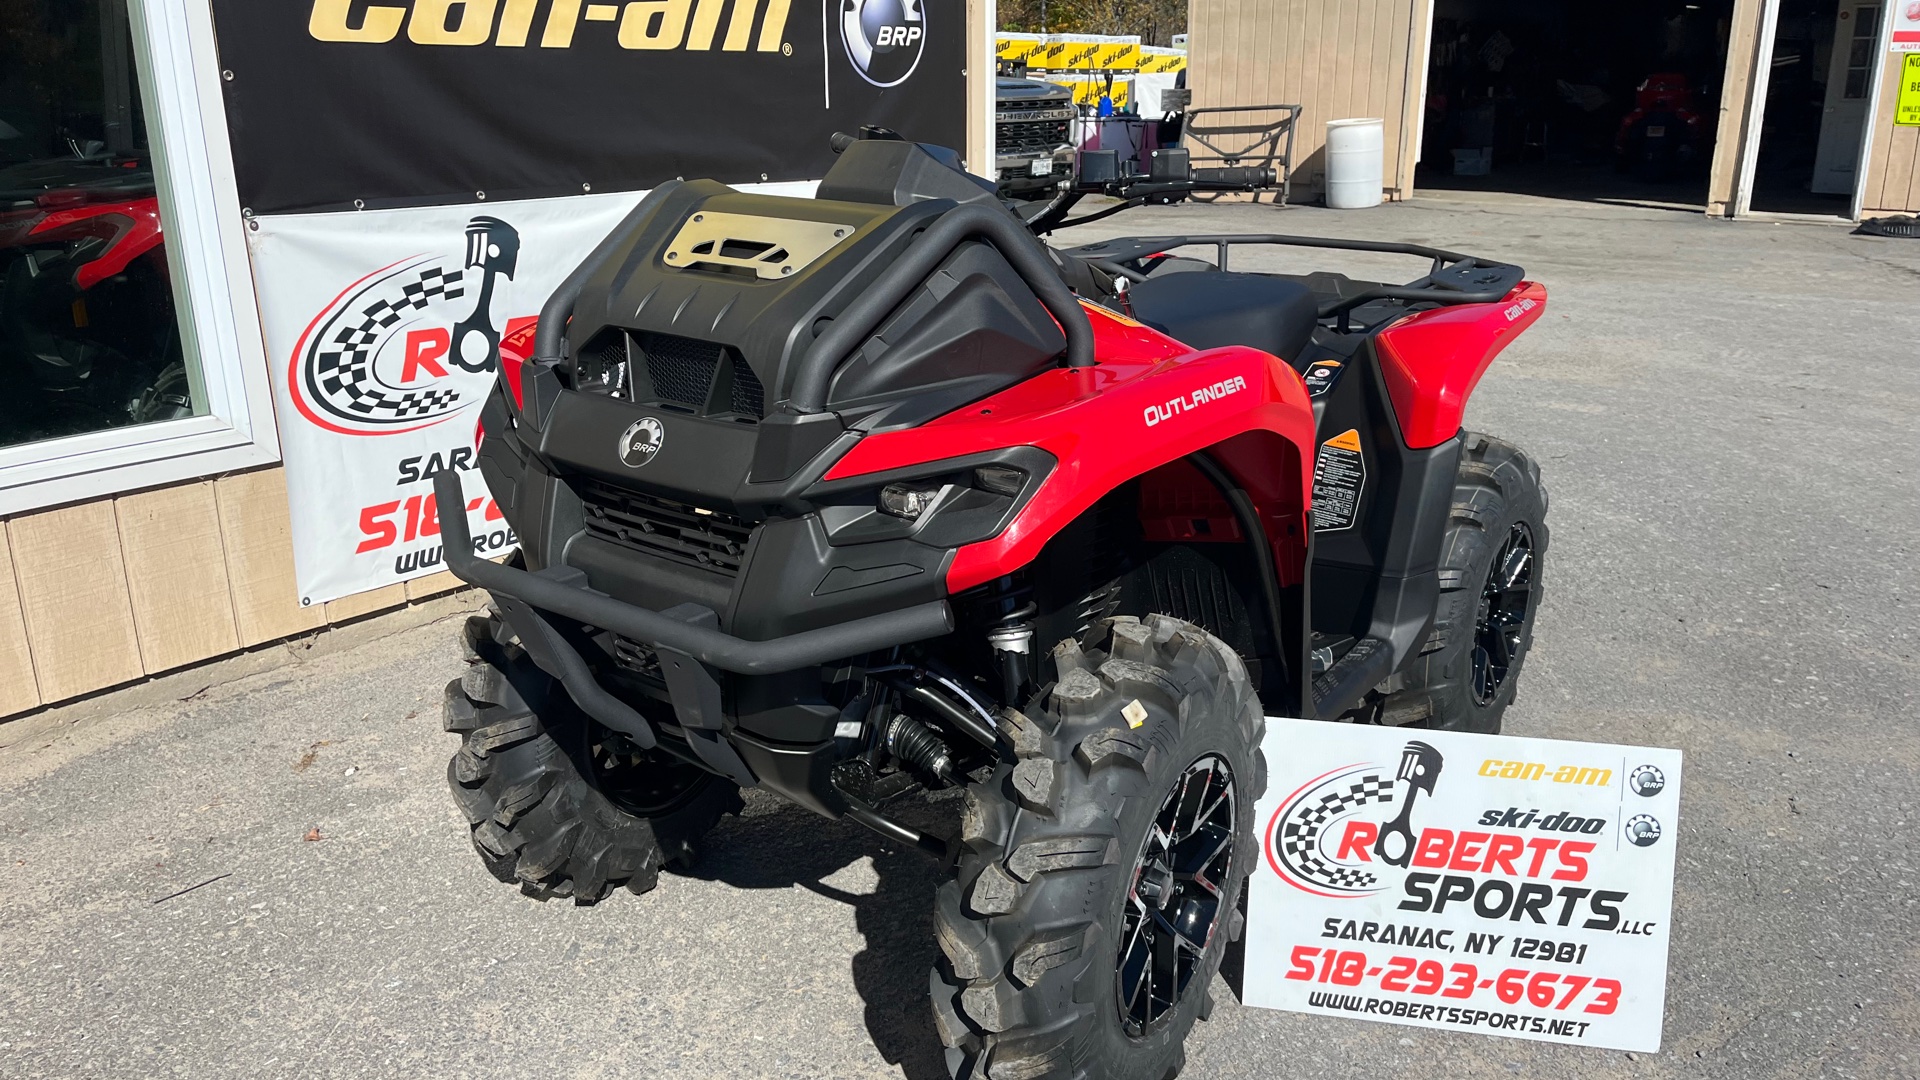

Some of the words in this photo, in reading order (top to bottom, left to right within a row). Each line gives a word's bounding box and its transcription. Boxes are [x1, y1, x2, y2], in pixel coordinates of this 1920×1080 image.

[877, 26, 922, 47] BRP
[1068, 44, 1100, 67] ski-doo
[1102, 45, 1133, 68] ski-doo
[1504, 298, 1537, 322] can-am
[1143, 375, 1247, 427] OUTLANDER
[632, 442, 657, 454] BRP
[1478, 759, 1613, 787] can-am
[1643, 781, 1664, 789] BRP
[1478, 807, 1607, 835] ski-doo
[1639, 831, 1660, 839] BRP
[1336, 820, 1598, 883] ROBERTS
[1321, 917, 1455, 954] SARANAC,
[1463, 932, 1505, 956] NY
[1510, 937, 1588, 965] 12981
[1284, 945, 1622, 1016] 518-293-6673
[1308, 991, 1591, 1038] WWW.ROBERTSSPORTS.NET
